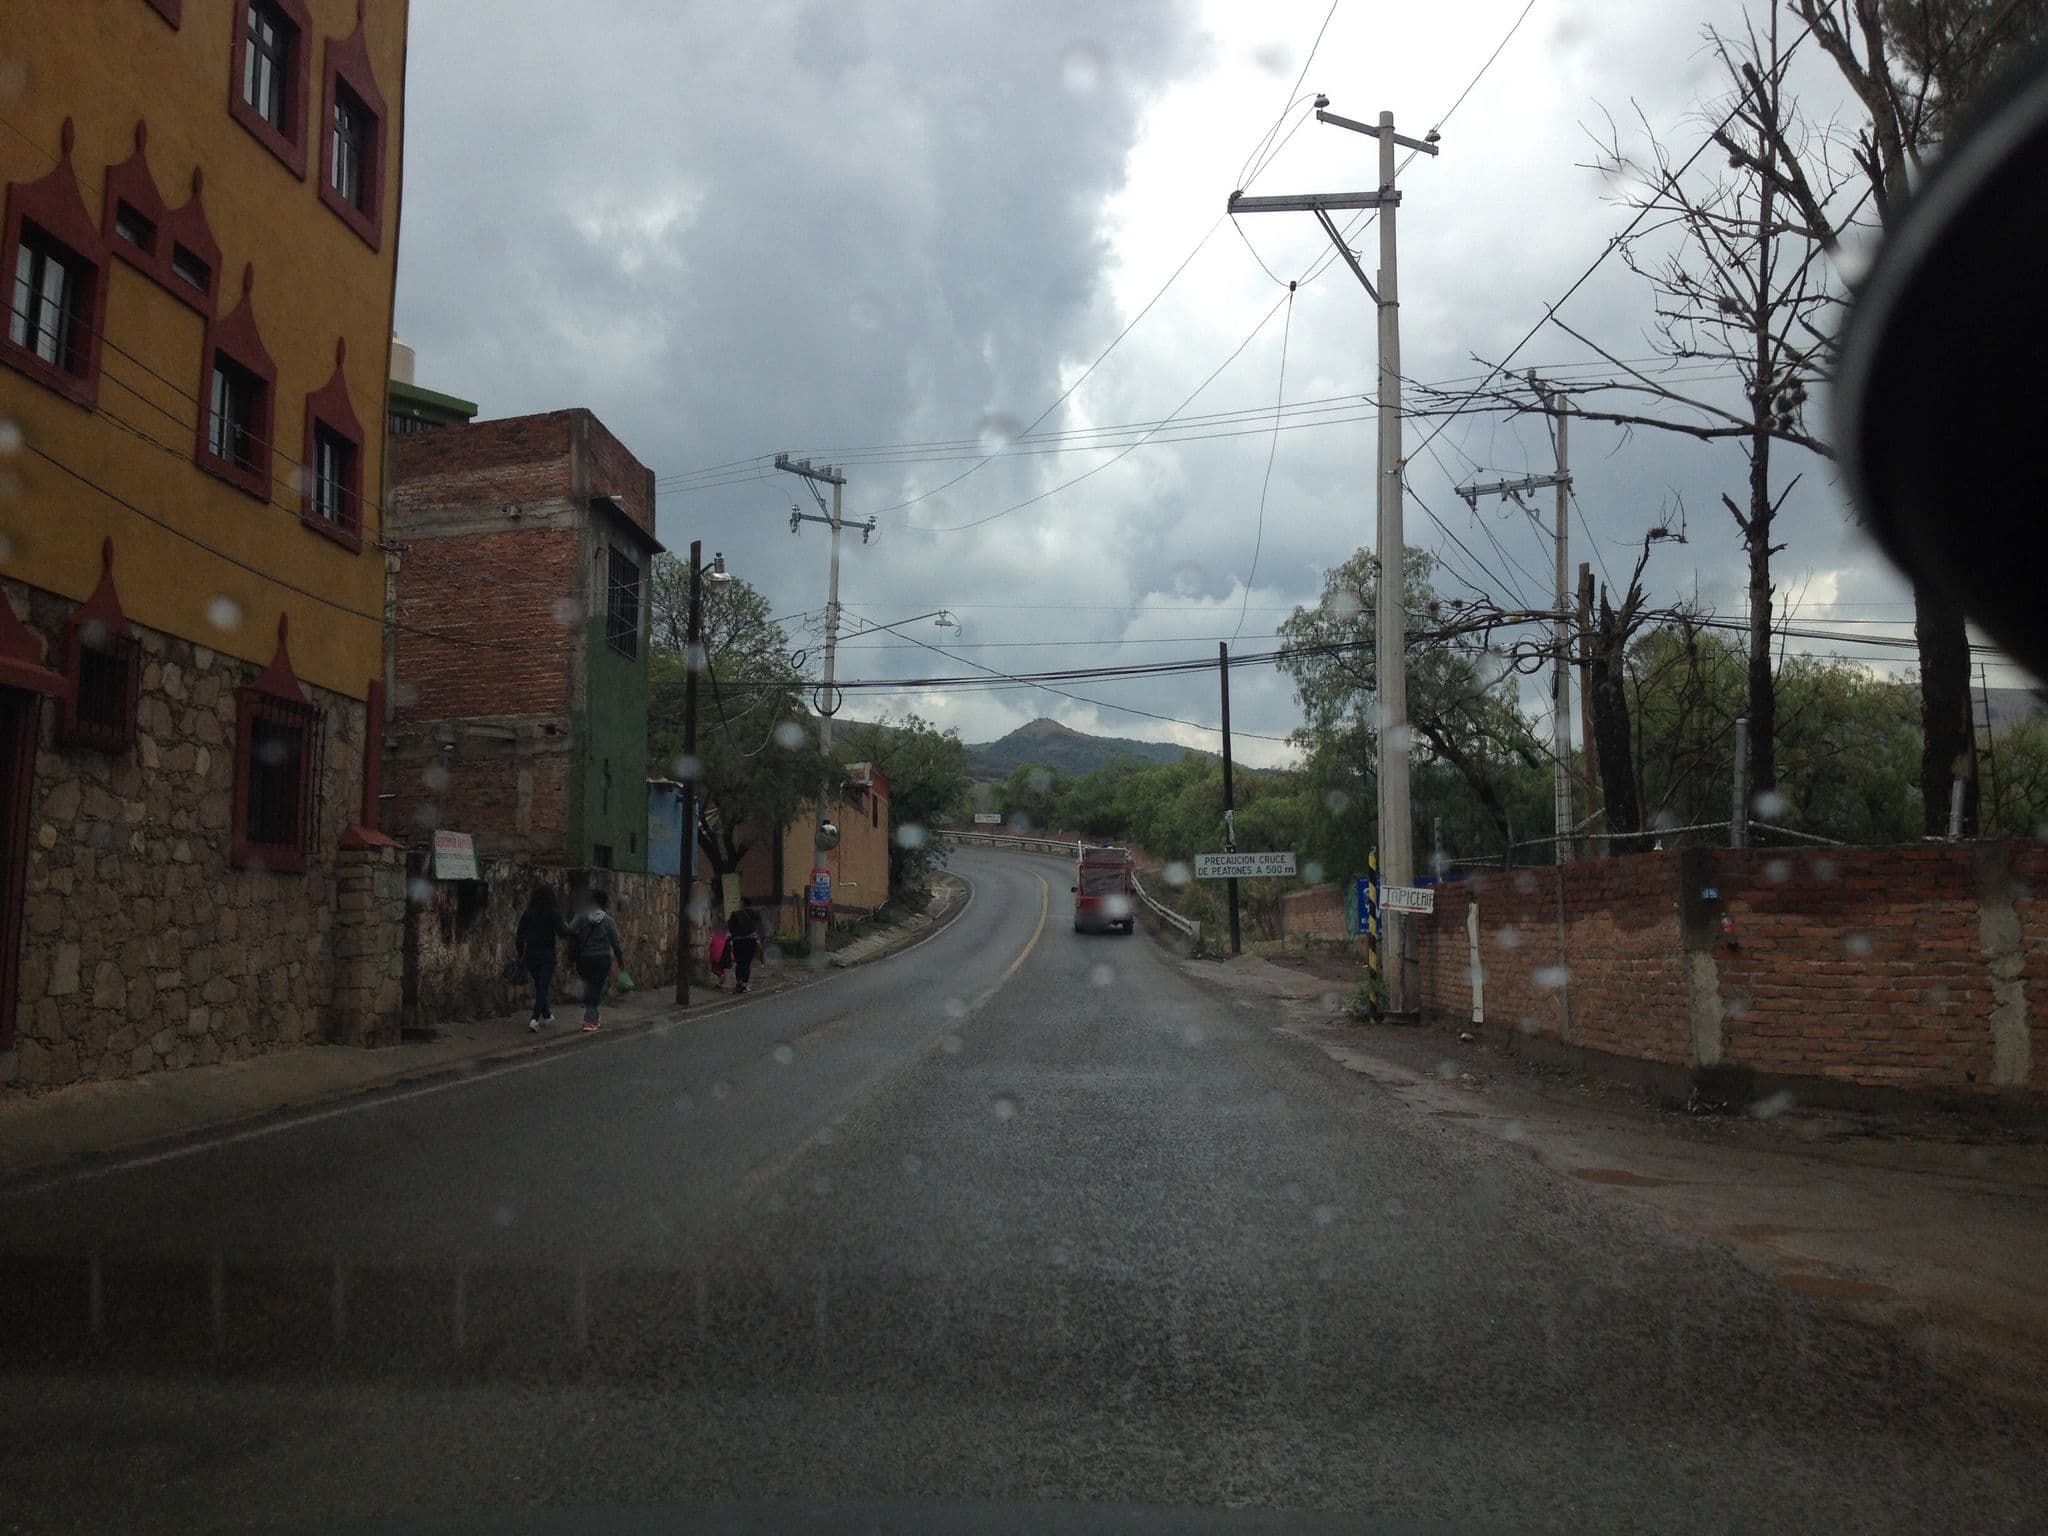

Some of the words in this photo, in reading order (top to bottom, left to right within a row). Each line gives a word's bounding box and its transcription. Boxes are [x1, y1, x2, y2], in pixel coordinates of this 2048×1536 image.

[1204, 855, 1255, 865] PRECAUCION
[1259, 854, 1286, 864] CRUCE
[1198, 867, 1208, 876] DE
[1211, 866, 1252, 875] PEATONES
[1256, 866, 1262, 874] A
[1266, 865, 1282, 874] 500
